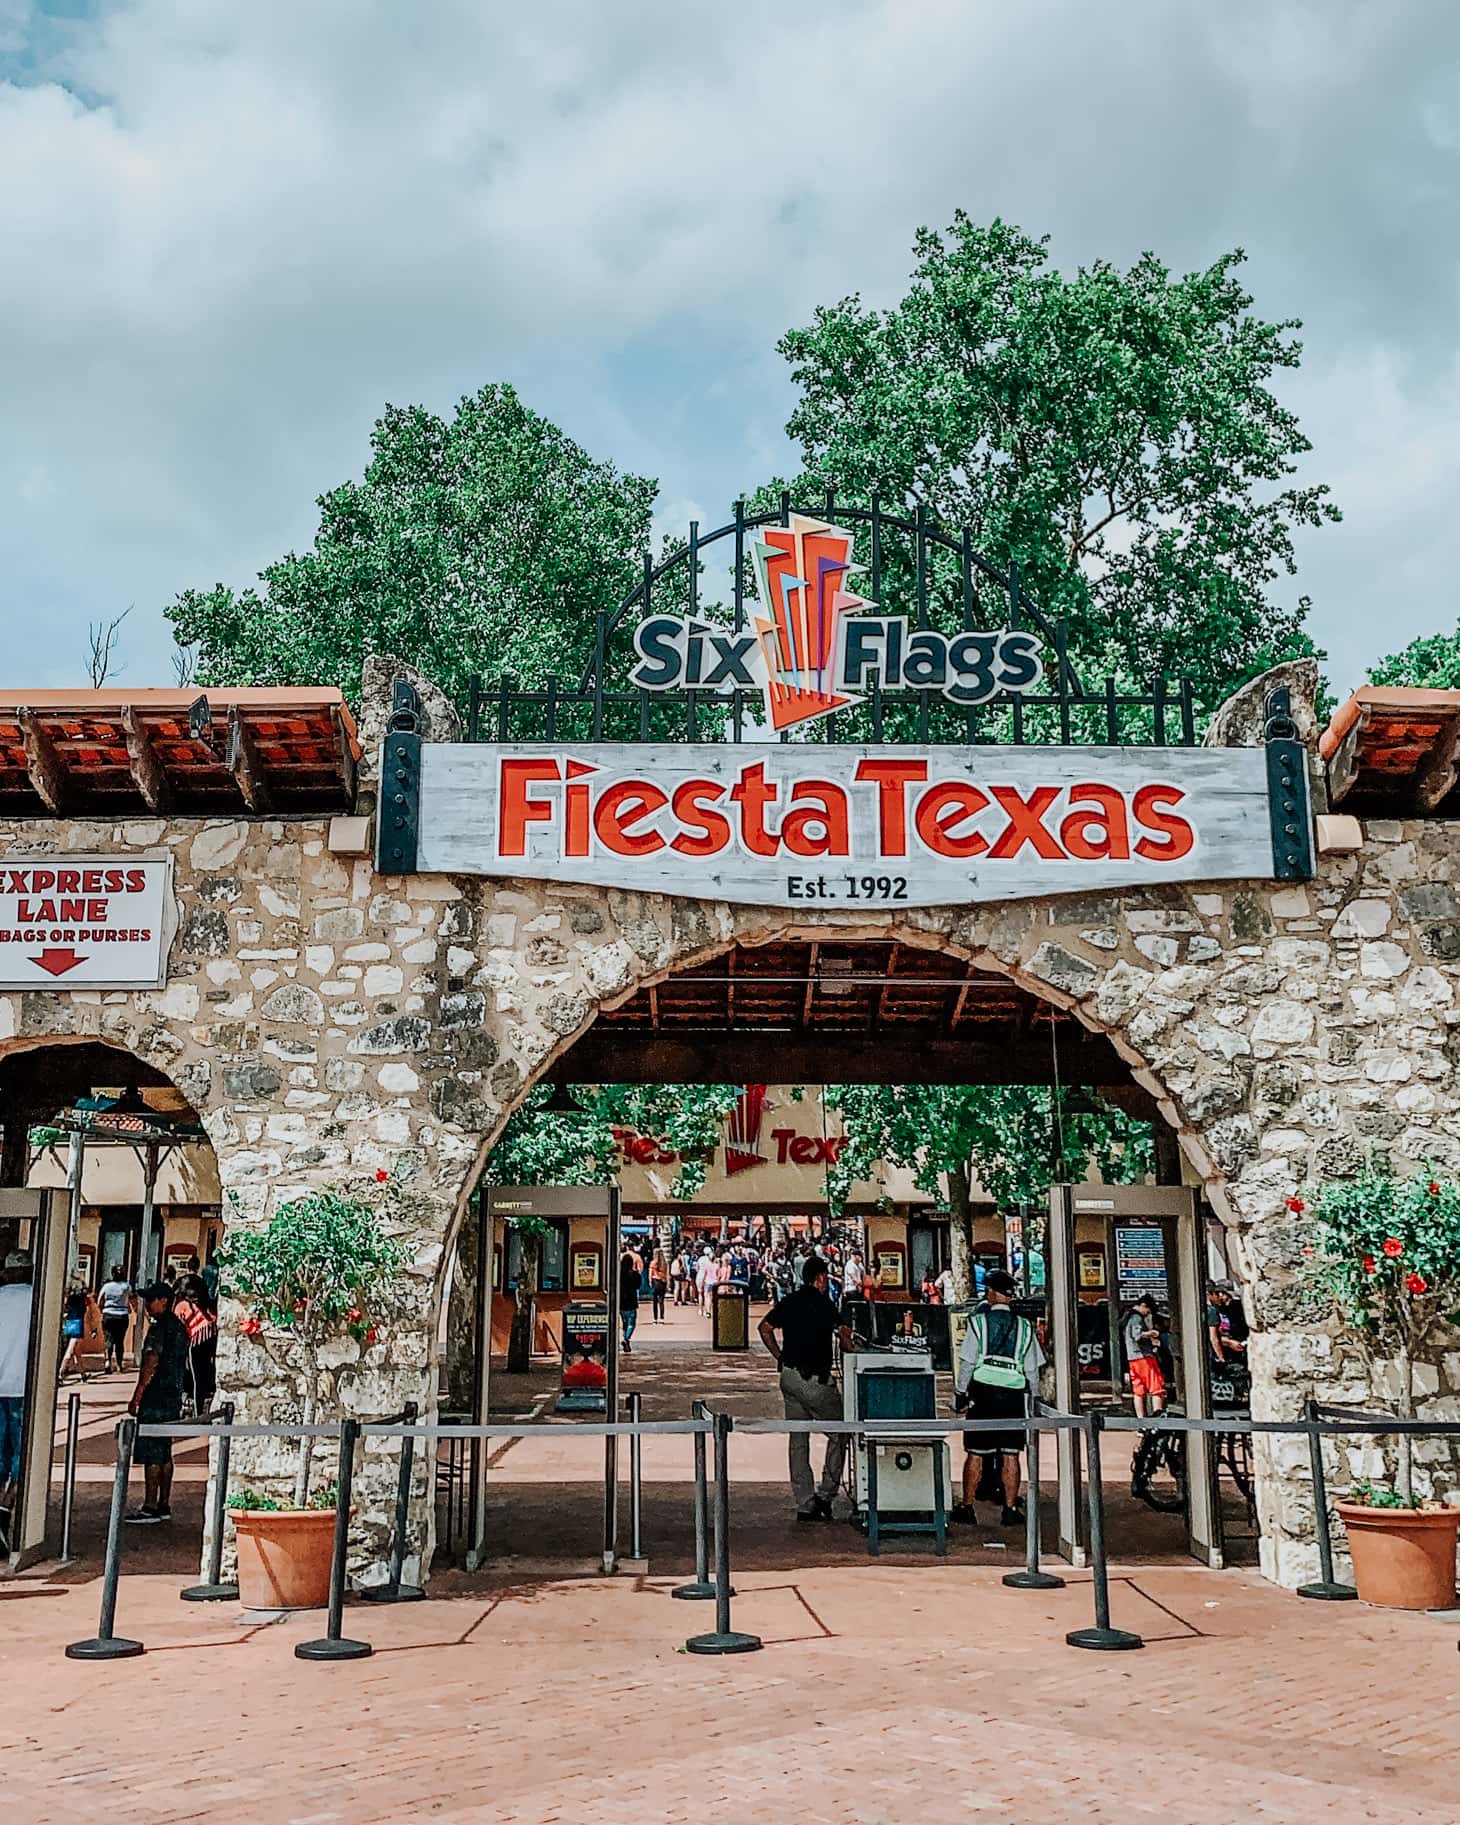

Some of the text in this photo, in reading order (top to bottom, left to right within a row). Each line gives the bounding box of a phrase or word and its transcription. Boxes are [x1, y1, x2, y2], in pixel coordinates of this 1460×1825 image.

[634, 618, 1038, 700] Six Flags
[498, 758, 1195, 862] Fiesta Texas
[0, 869, 147, 894] XPRESS
[786, 875, 909, 899] Est. 1992
[16, 898, 110, 923] LANE
[0, 928, 152, 943] BAGS OR PURSES
